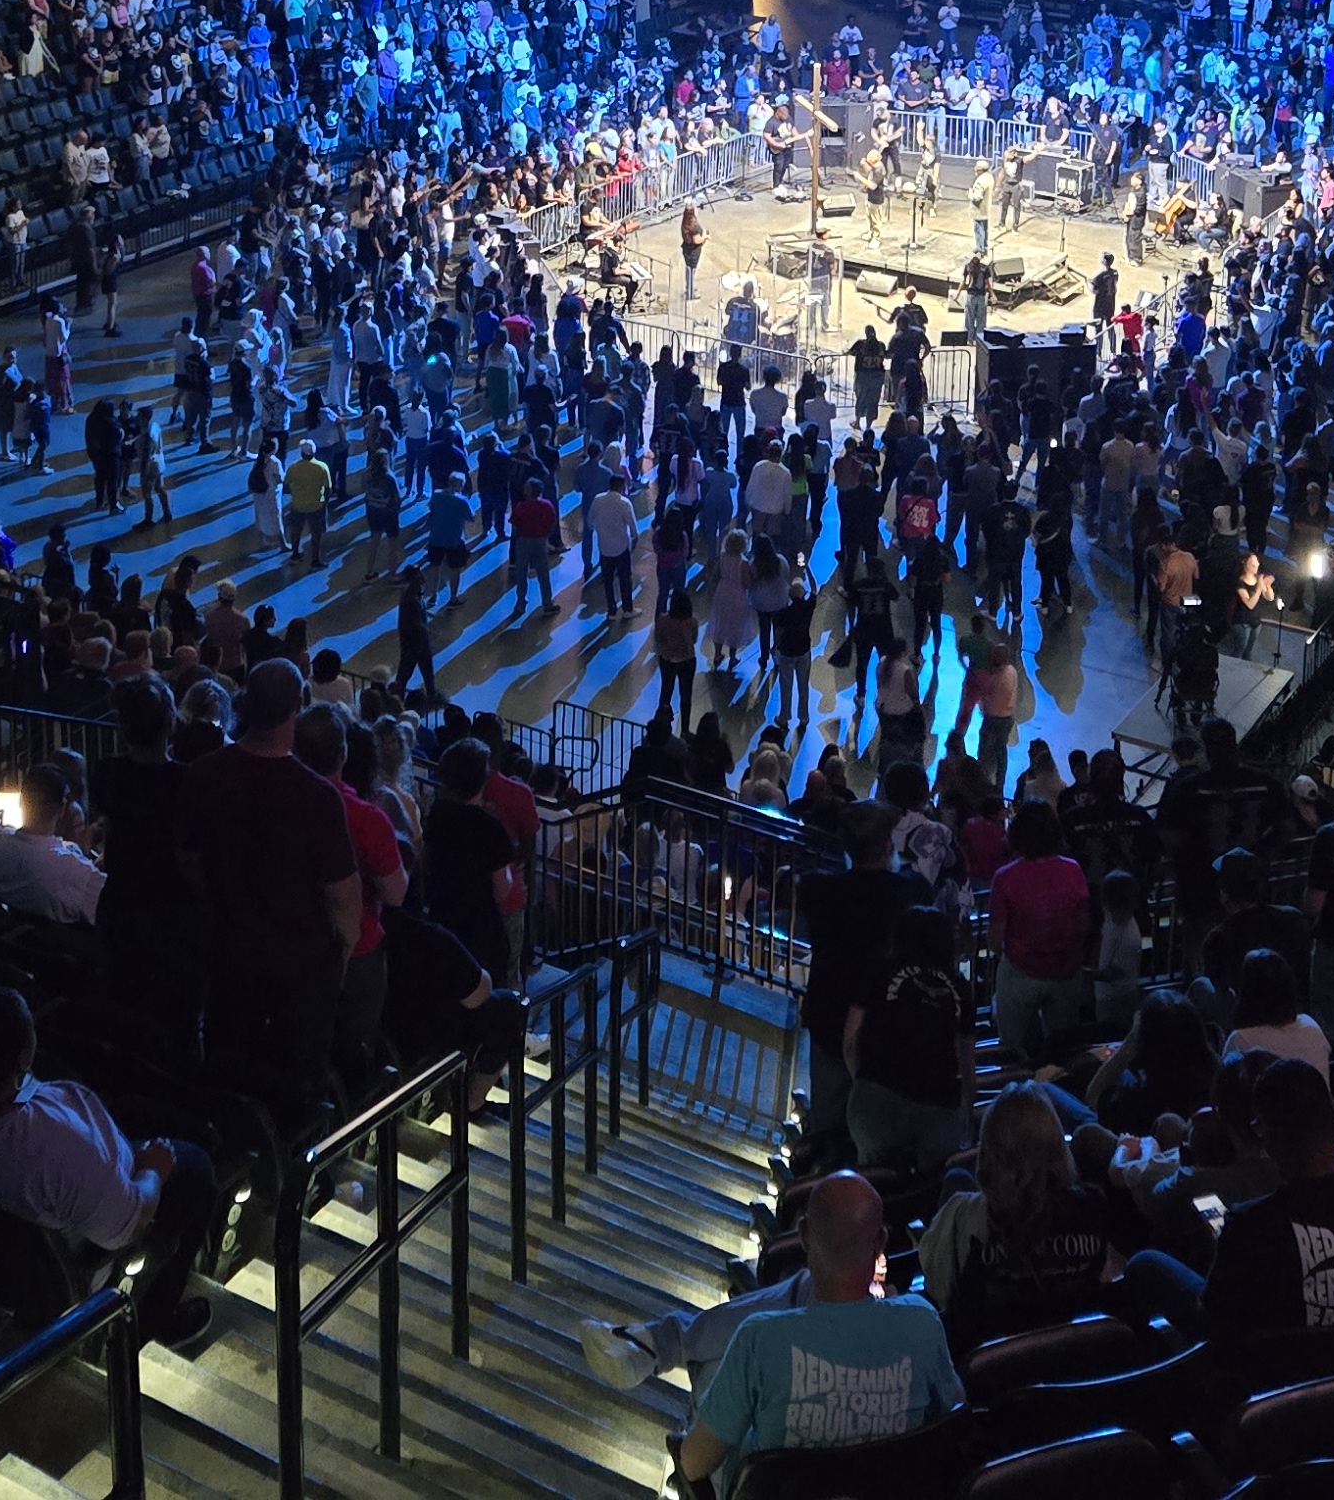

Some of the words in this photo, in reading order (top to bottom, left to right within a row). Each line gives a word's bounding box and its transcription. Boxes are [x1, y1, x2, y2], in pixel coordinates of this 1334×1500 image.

[981, 1243, 1010, 1267] ON
[791, 1344, 912, 1401] REDEEMING
[827, 1389, 910, 1418] STORIES
[785, 1403, 907, 1442] REBUILDING
